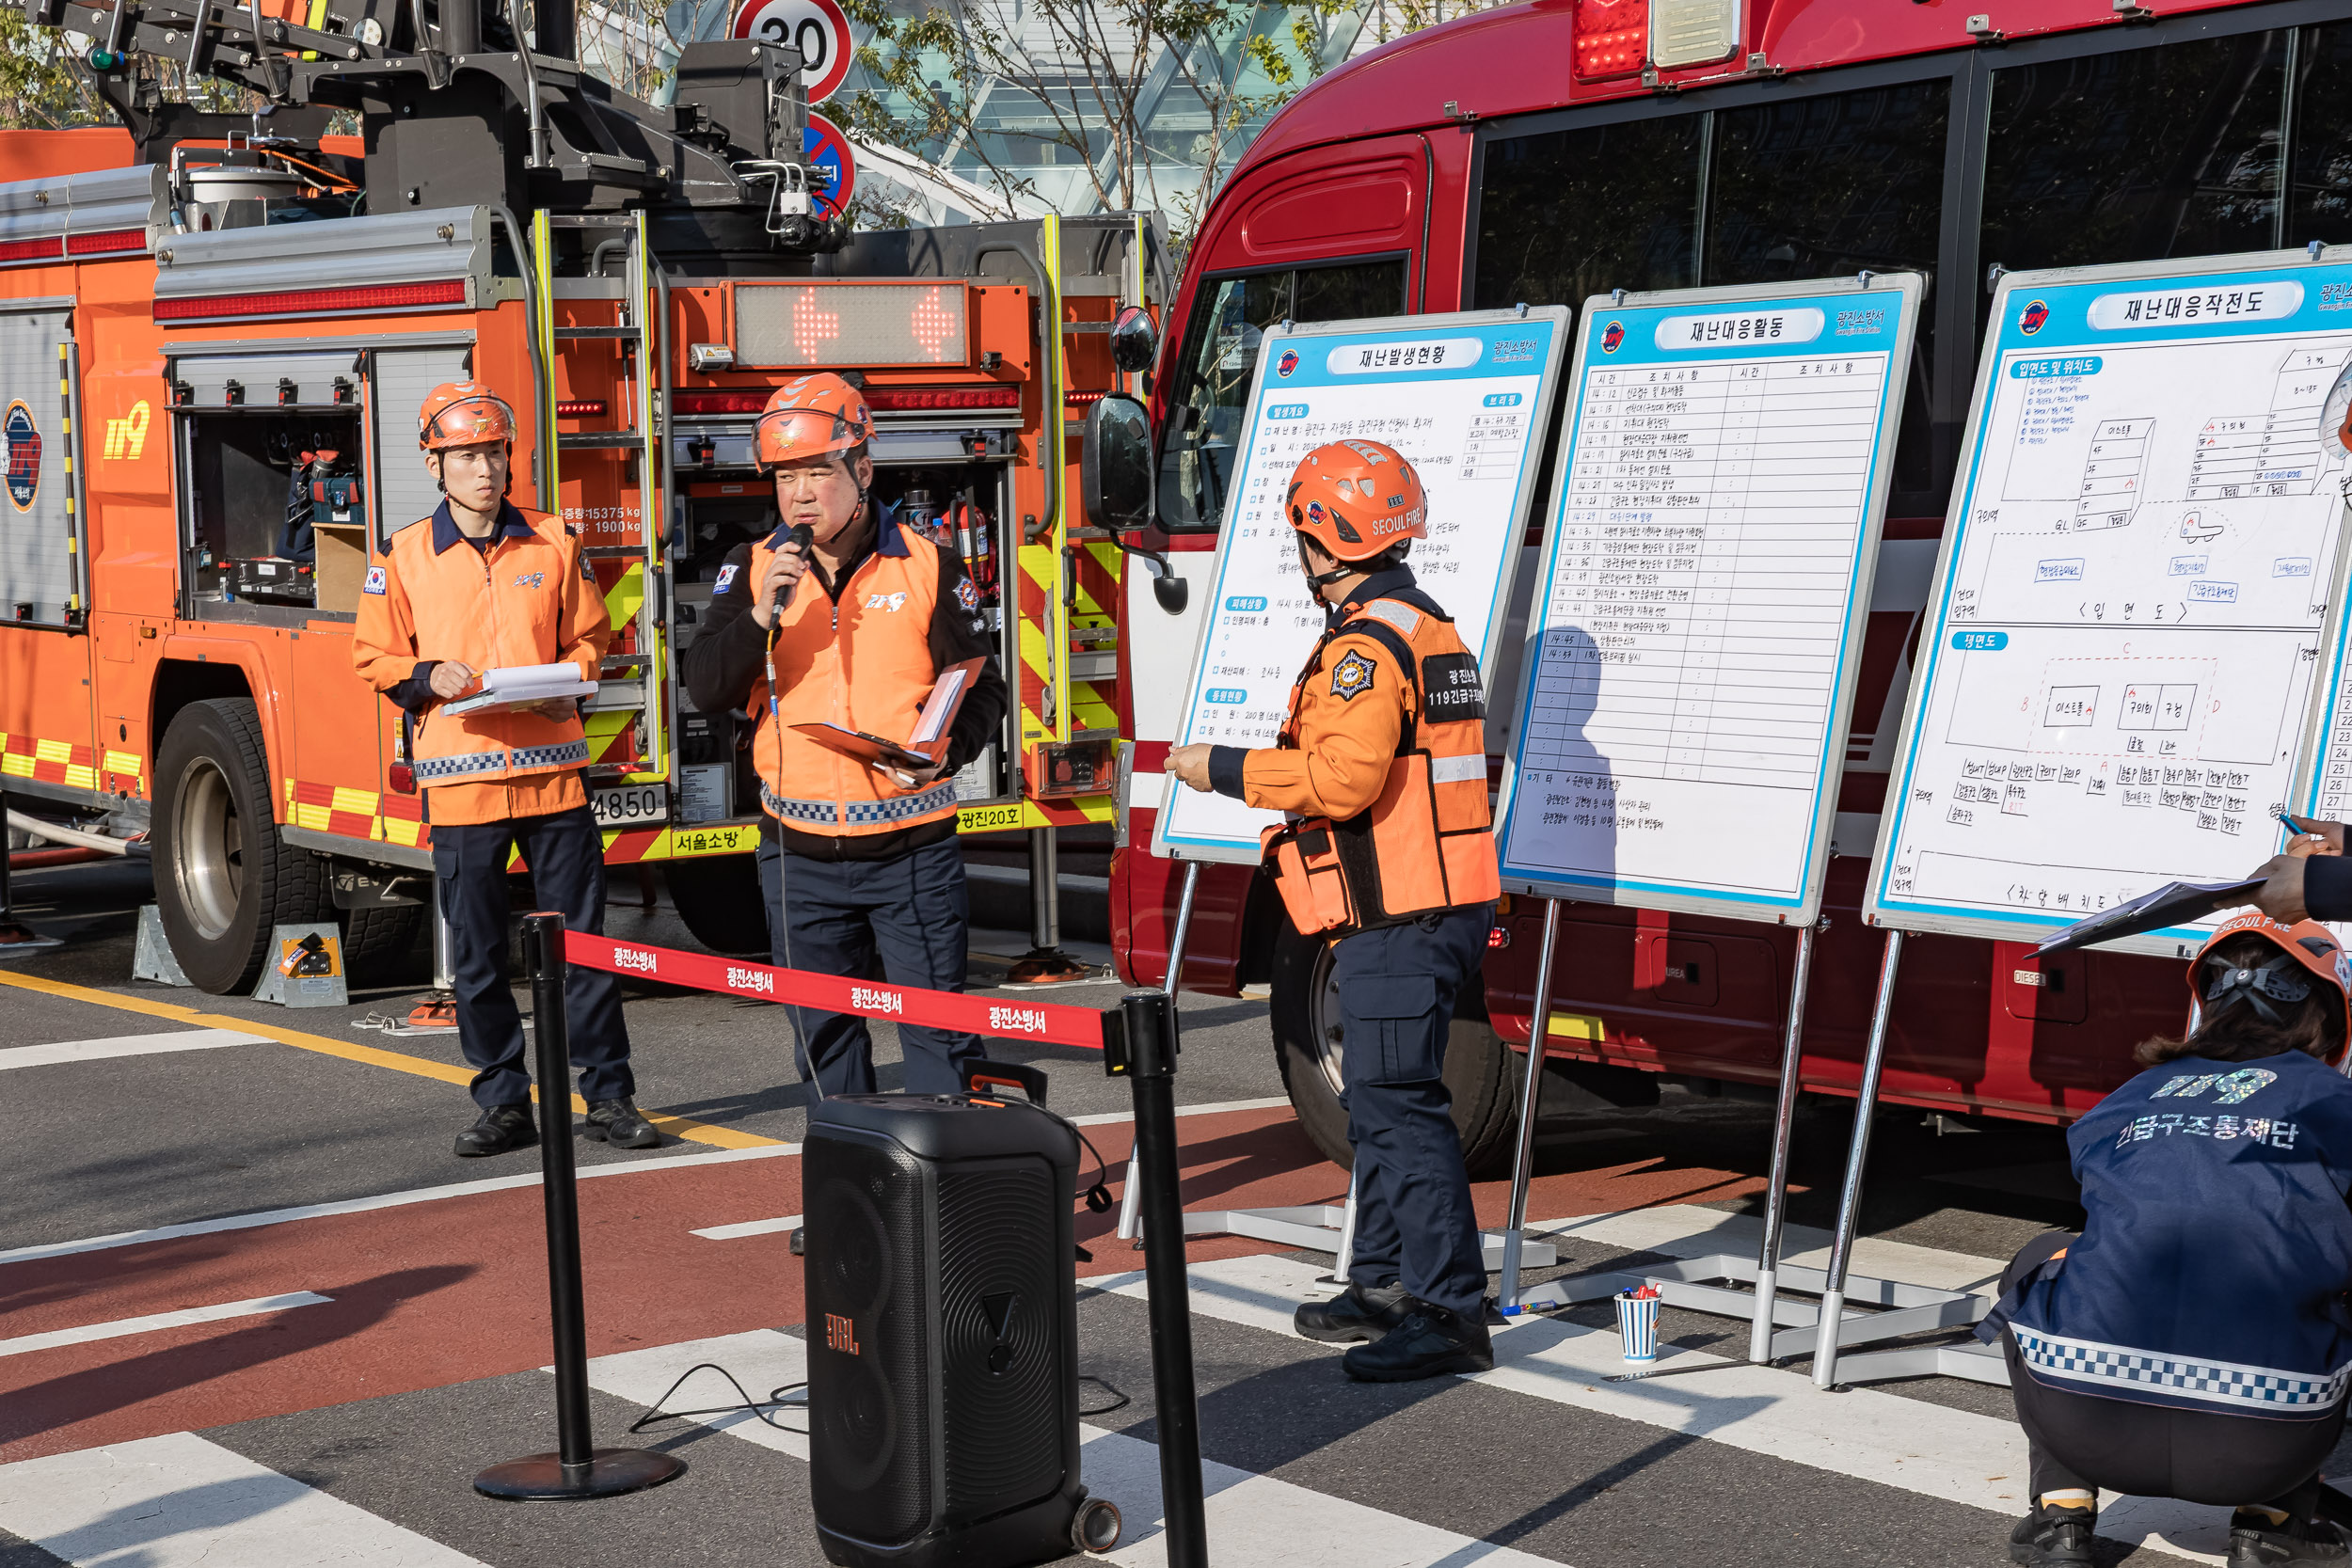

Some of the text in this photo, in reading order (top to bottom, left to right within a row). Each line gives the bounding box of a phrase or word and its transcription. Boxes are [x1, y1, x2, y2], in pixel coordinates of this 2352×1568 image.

[2124, 290, 2264, 322] 재난대응작전도
[1836, 309, 1885, 327] 광진소방서
[1690, 317, 1784, 341] 재난대응활동
[1359, 345, 1446, 368] 재난발생현황
[1493, 339, 1538, 357] 광진소방서
[2019, 358, 2094, 376] 입면도 및 위치도
[1488, 395, 1518, 406] 브리핑
[103, 400, 151, 460] 119
[627, 506, 641, 518] kg
[1372, 507, 1422, 536] SEOUL FIRE
[596, 520, 641, 533] 1900 kg
[512, 571, 546, 590] 119
[866, 592, 907, 612] 119
[1963, 634, 1996, 648] 평면도
[2339, 732, 2350, 742] 23
[2336, 749, 2347, 758] 24
[2333, 764, 2344, 774] 25
[2329, 780, 2342, 790] 26
[595, 789, 657, 821] 4850
[2328, 796, 2339, 806] 27
[961, 808, 1020, 829] 광진20호
[2324, 813, 2337, 822] 28
[677, 831, 739, 851] 서울소방
[2218, 916, 2261, 935] SEOUL
[613, 947, 658, 974] 광진소방서
[726, 966, 773, 994] 광진소방서
[1665, 967, 1685, 979] UREA
[2015, 972, 2045, 986] DIESEL
[850, 987, 902, 1015] 광진소방서
[989, 1006, 1046, 1034] 광진소방서
[2149, 1068, 2279, 1104] 119
[2116, 1113, 2299, 1150] 긴급구조통제단
[824, 1312, 860, 1355] JBL
